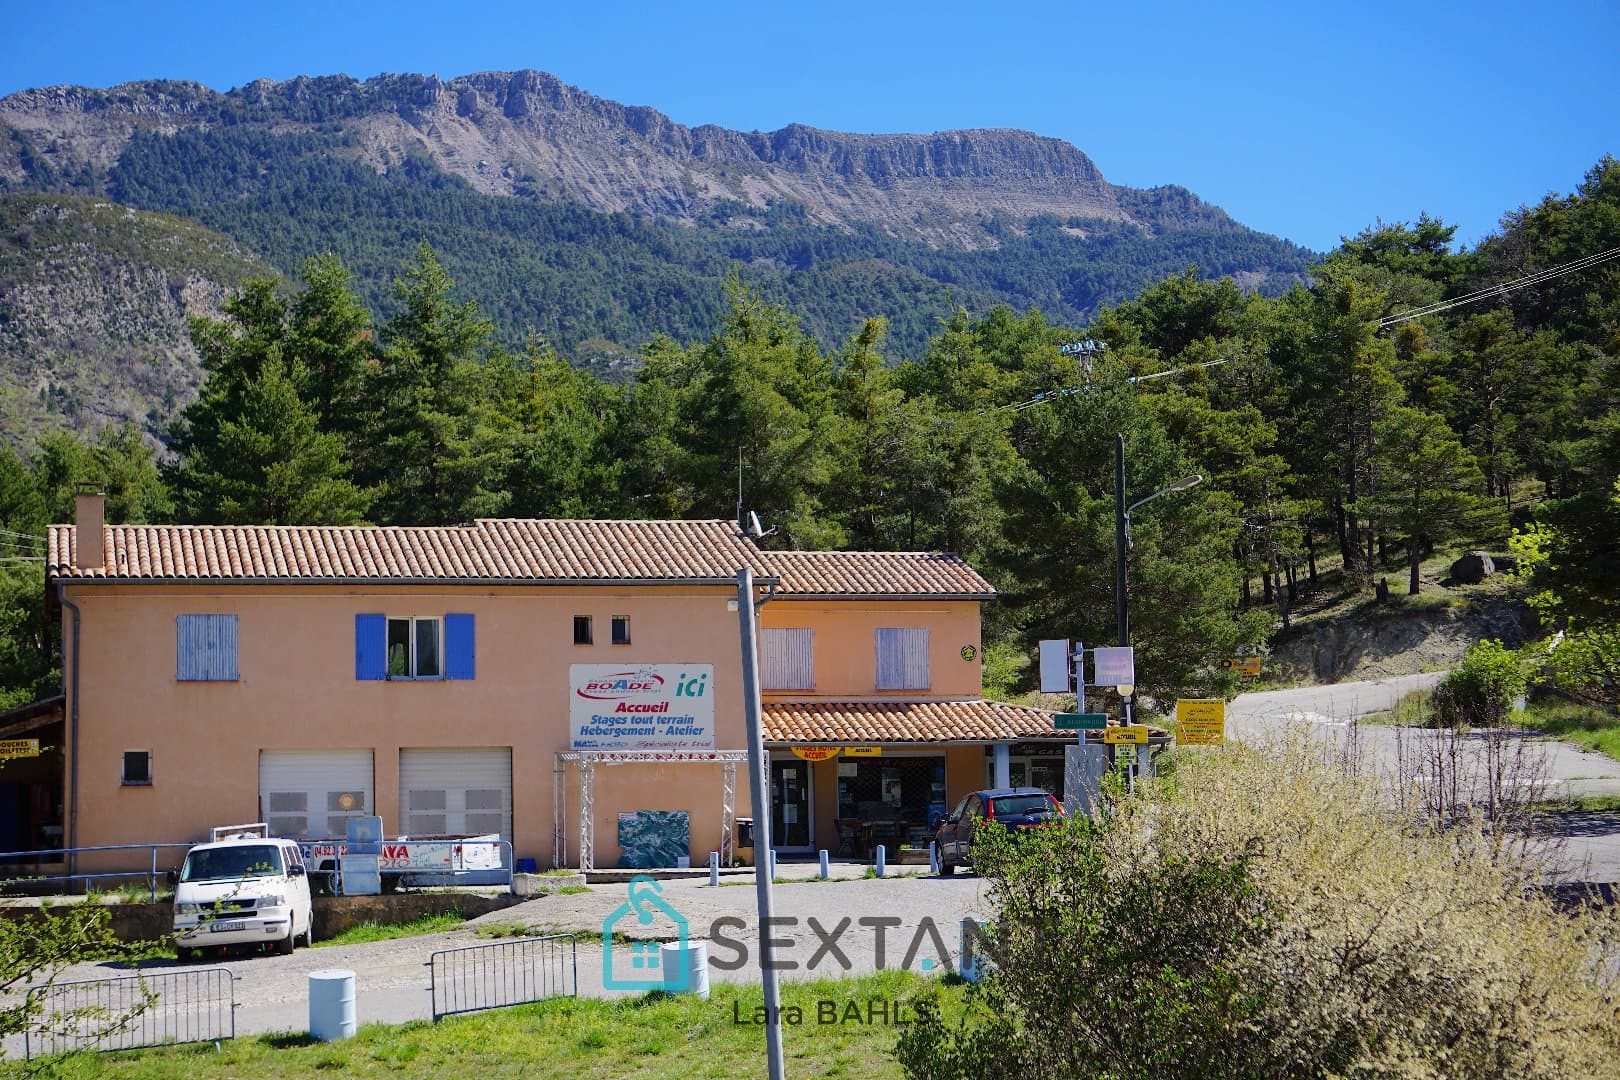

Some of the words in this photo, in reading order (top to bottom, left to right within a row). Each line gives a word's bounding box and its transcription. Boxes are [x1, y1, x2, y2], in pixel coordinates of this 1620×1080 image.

[586, 679, 655, 690] BOADE
[615, 702, 669, 713] Accueil
[590, 715, 627, 726] Stages
[630, 715, 653, 725] tout
[656, 714, 694, 725] terrain
[580, 726, 655, 737] Hebergement
[665, 726, 704, 736] Atelier
